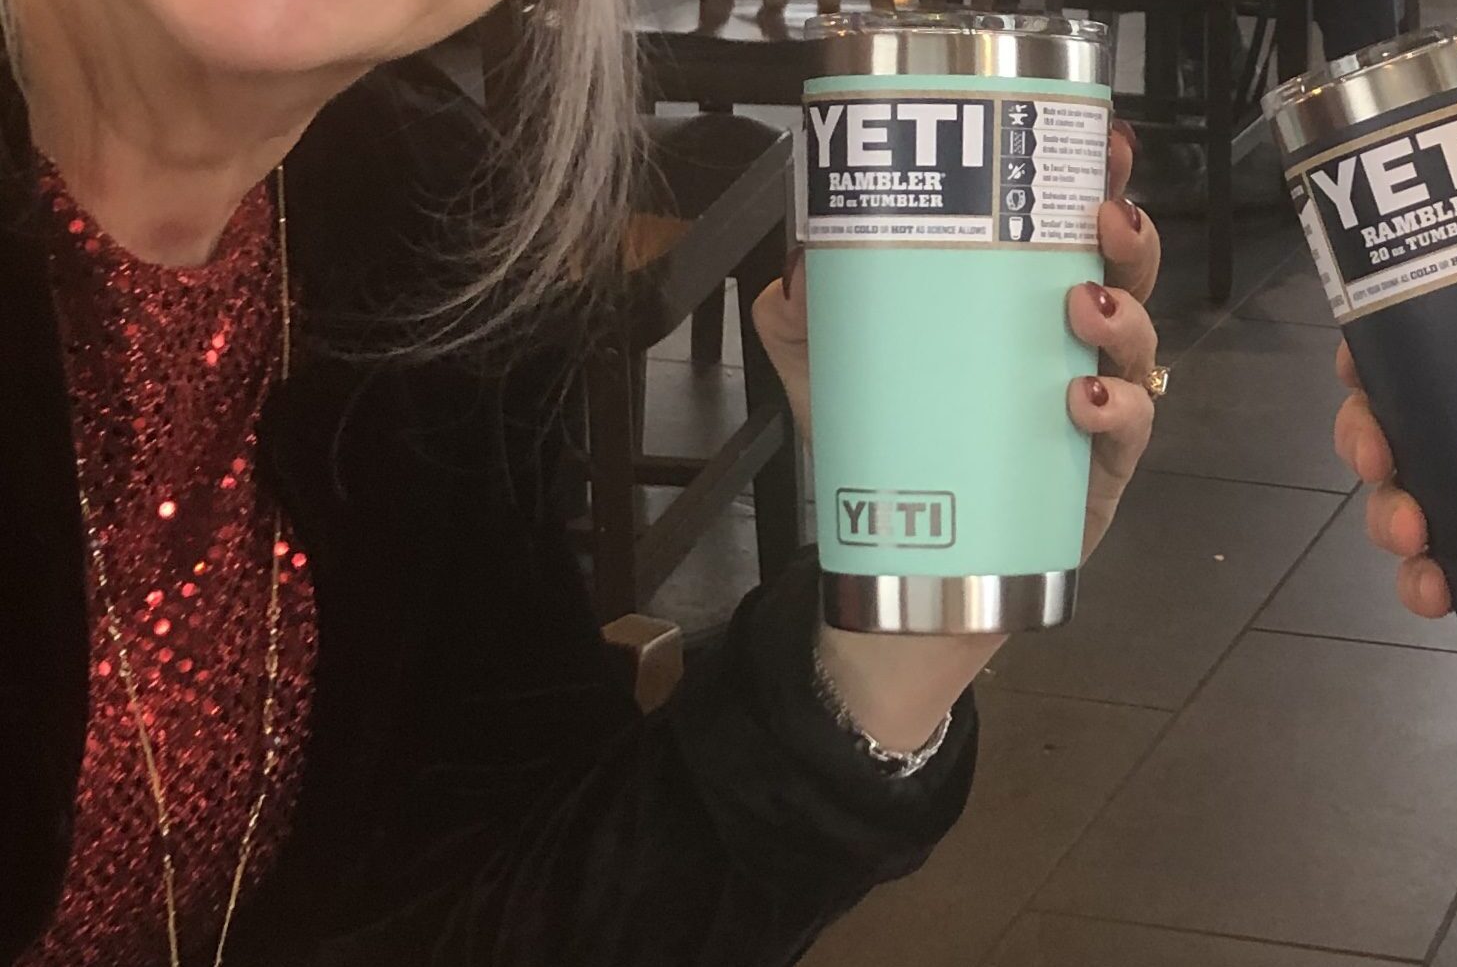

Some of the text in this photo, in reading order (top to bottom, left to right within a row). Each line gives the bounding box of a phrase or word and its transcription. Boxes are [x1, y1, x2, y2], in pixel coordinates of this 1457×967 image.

[809, 104, 985, 168] YETI
[829, 194, 844, 208] 20
[860, 194, 944, 208] TUMBLER
[854, 225, 879, 234] COLD
[891, 225, 914, 235] HOT
[1369, 246, 1391, 265] 20
[1410, 264, 1439, 281] COLD
